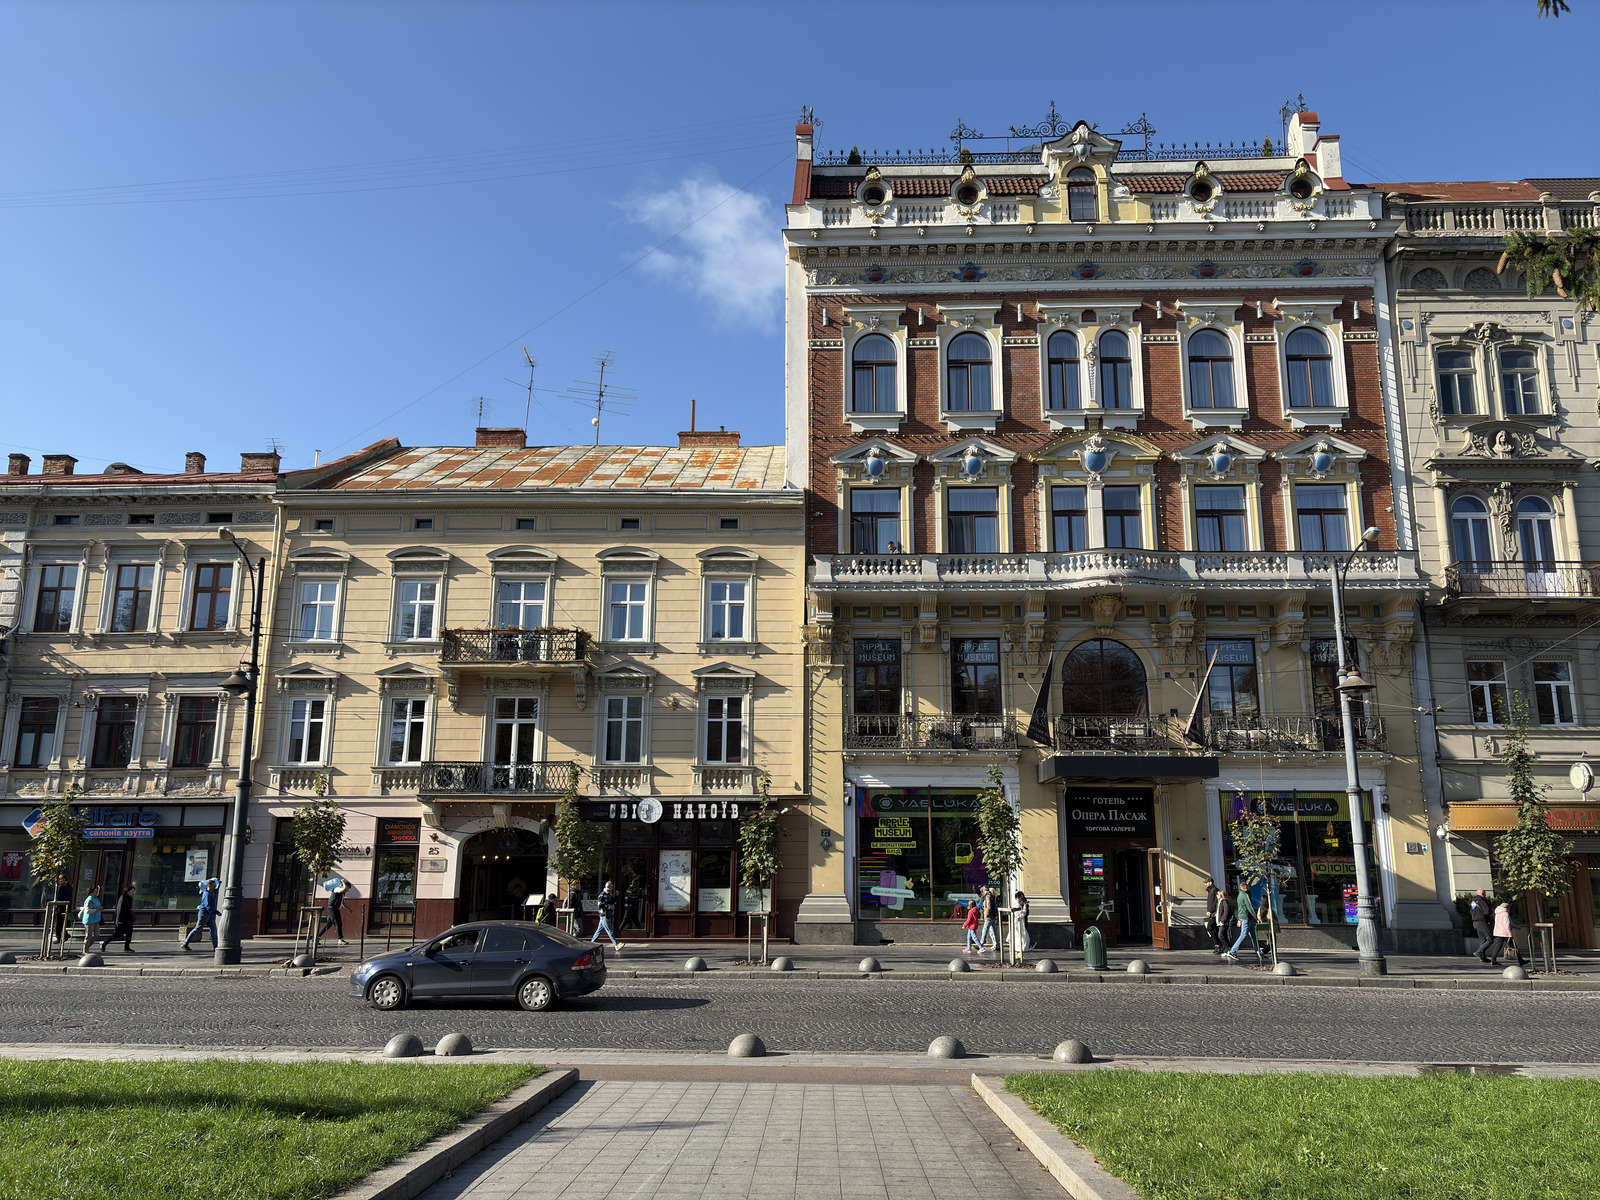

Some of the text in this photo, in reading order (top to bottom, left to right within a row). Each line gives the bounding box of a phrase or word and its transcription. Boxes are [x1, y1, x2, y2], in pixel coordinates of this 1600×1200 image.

[862, 643, 891, 651] APPLE
[960, 643, 990, 651] APPLE
[859, 654, 896, 662] MUSEUM
[957, 653, 994, 661] MUSEUM
[1092, 797, 1125, 805] ГОТЕЛЬ
[609, 801, 739, 819] СВІТ НАПОЇВ
[72, 807, 156, 826] elfare
[879, 818, 909, 827] APPLE
[124, 830, 151, 838] взуття
[876, 828, 912, 837] MUSEUM
[428, 847, 440, 856] 25
